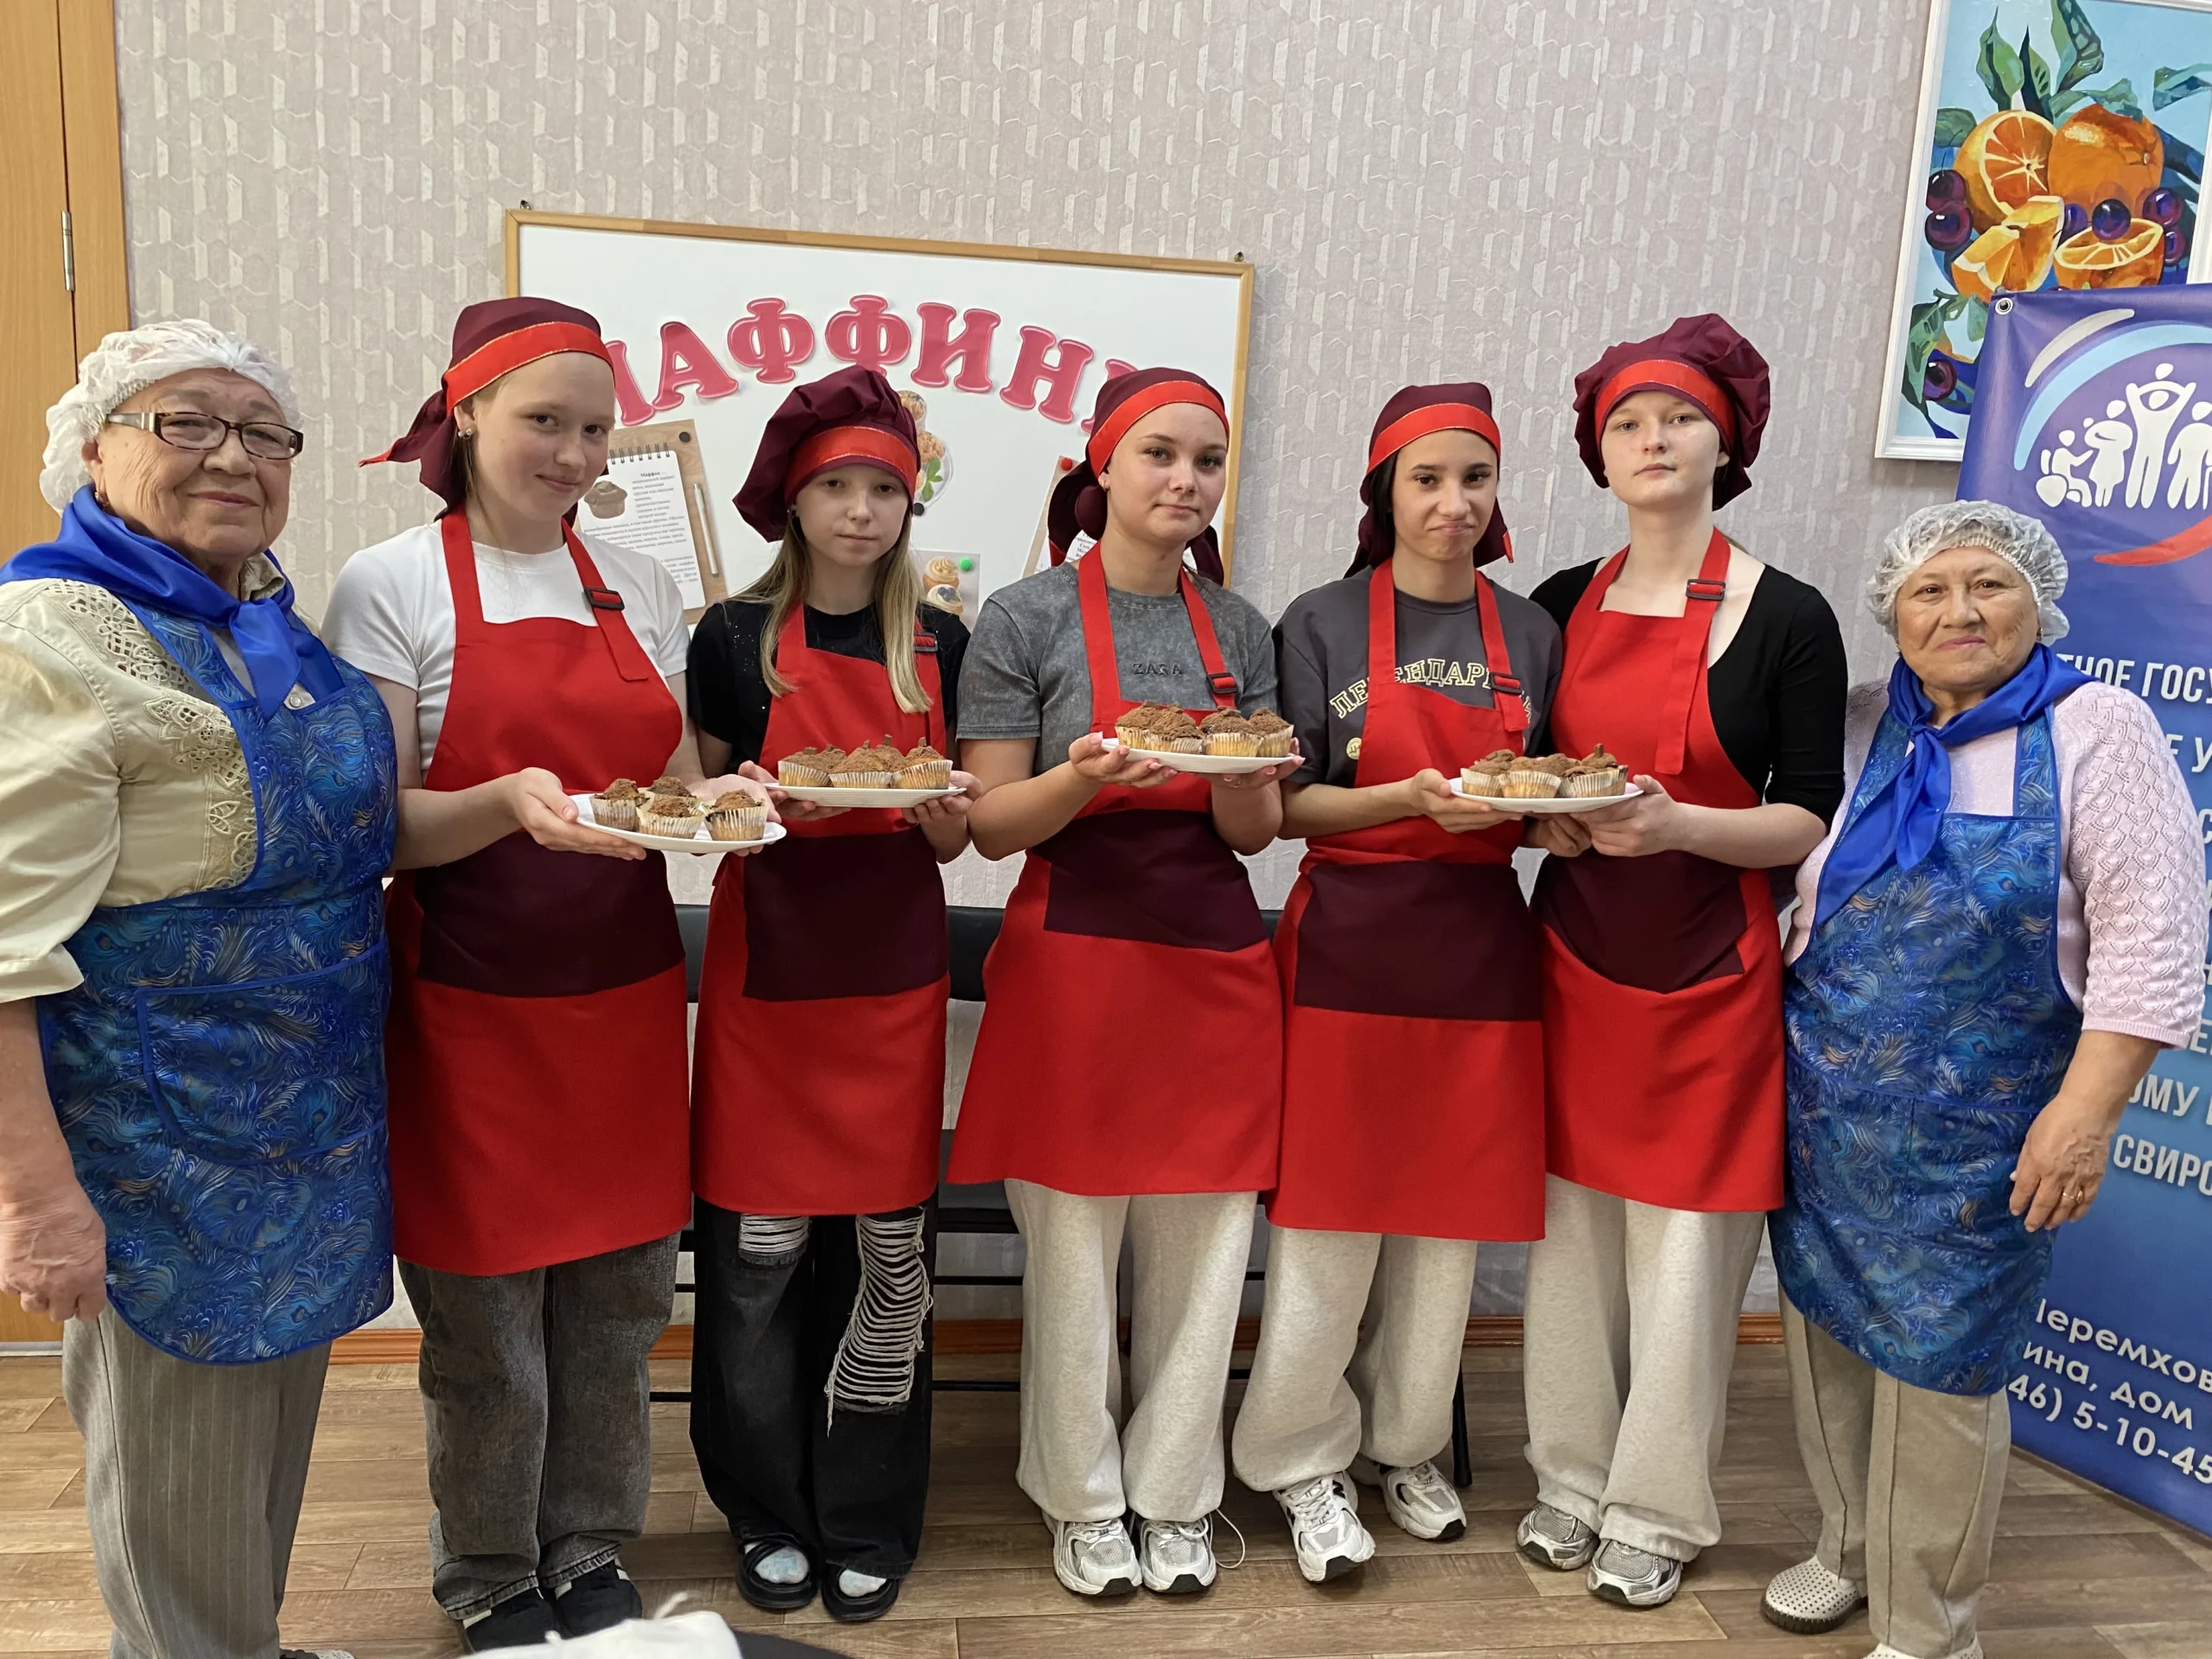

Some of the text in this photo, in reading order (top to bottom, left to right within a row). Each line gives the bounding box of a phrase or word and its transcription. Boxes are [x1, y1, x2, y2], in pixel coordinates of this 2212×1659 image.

[1133, 663, 1183, 676] ZARA
[2110, 1382, 2192, 1430] дом
[2073, 1401, 2212, 1484] 5-10-45
